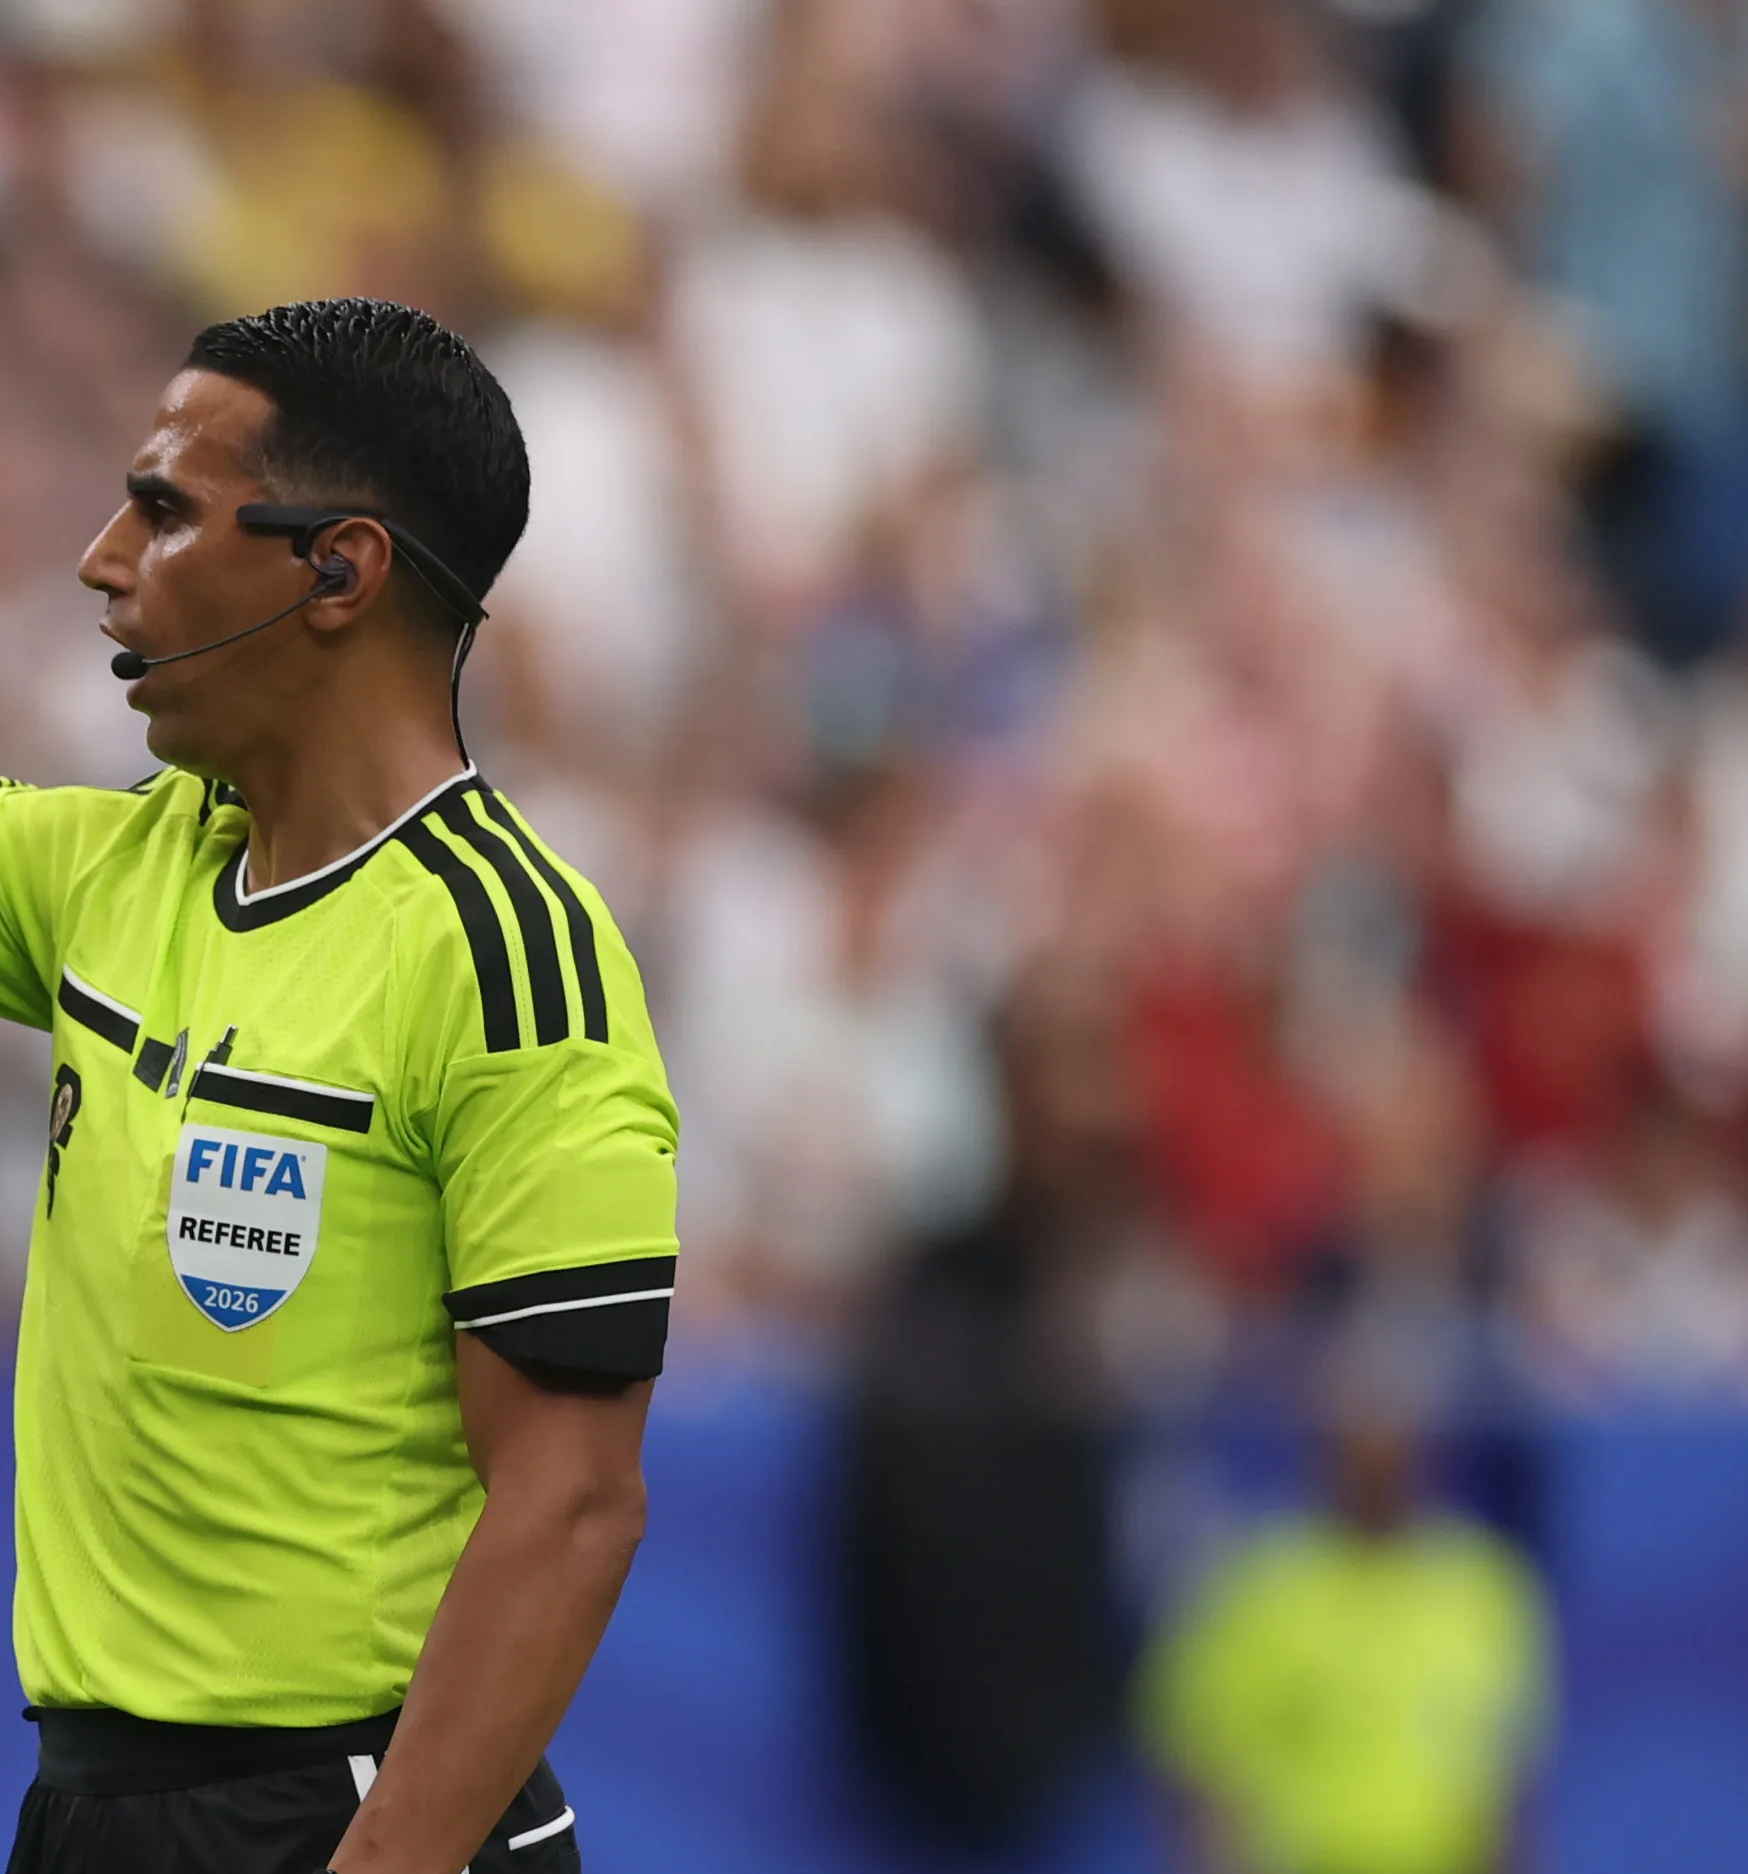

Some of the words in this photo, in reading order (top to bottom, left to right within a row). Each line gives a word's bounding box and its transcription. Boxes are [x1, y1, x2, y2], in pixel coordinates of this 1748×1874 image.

[186, 1138, 306, 1200] FIFA
[178, 1216, 301, 1257] REFEREE
[204, 1285, 259, 1313] 2026
